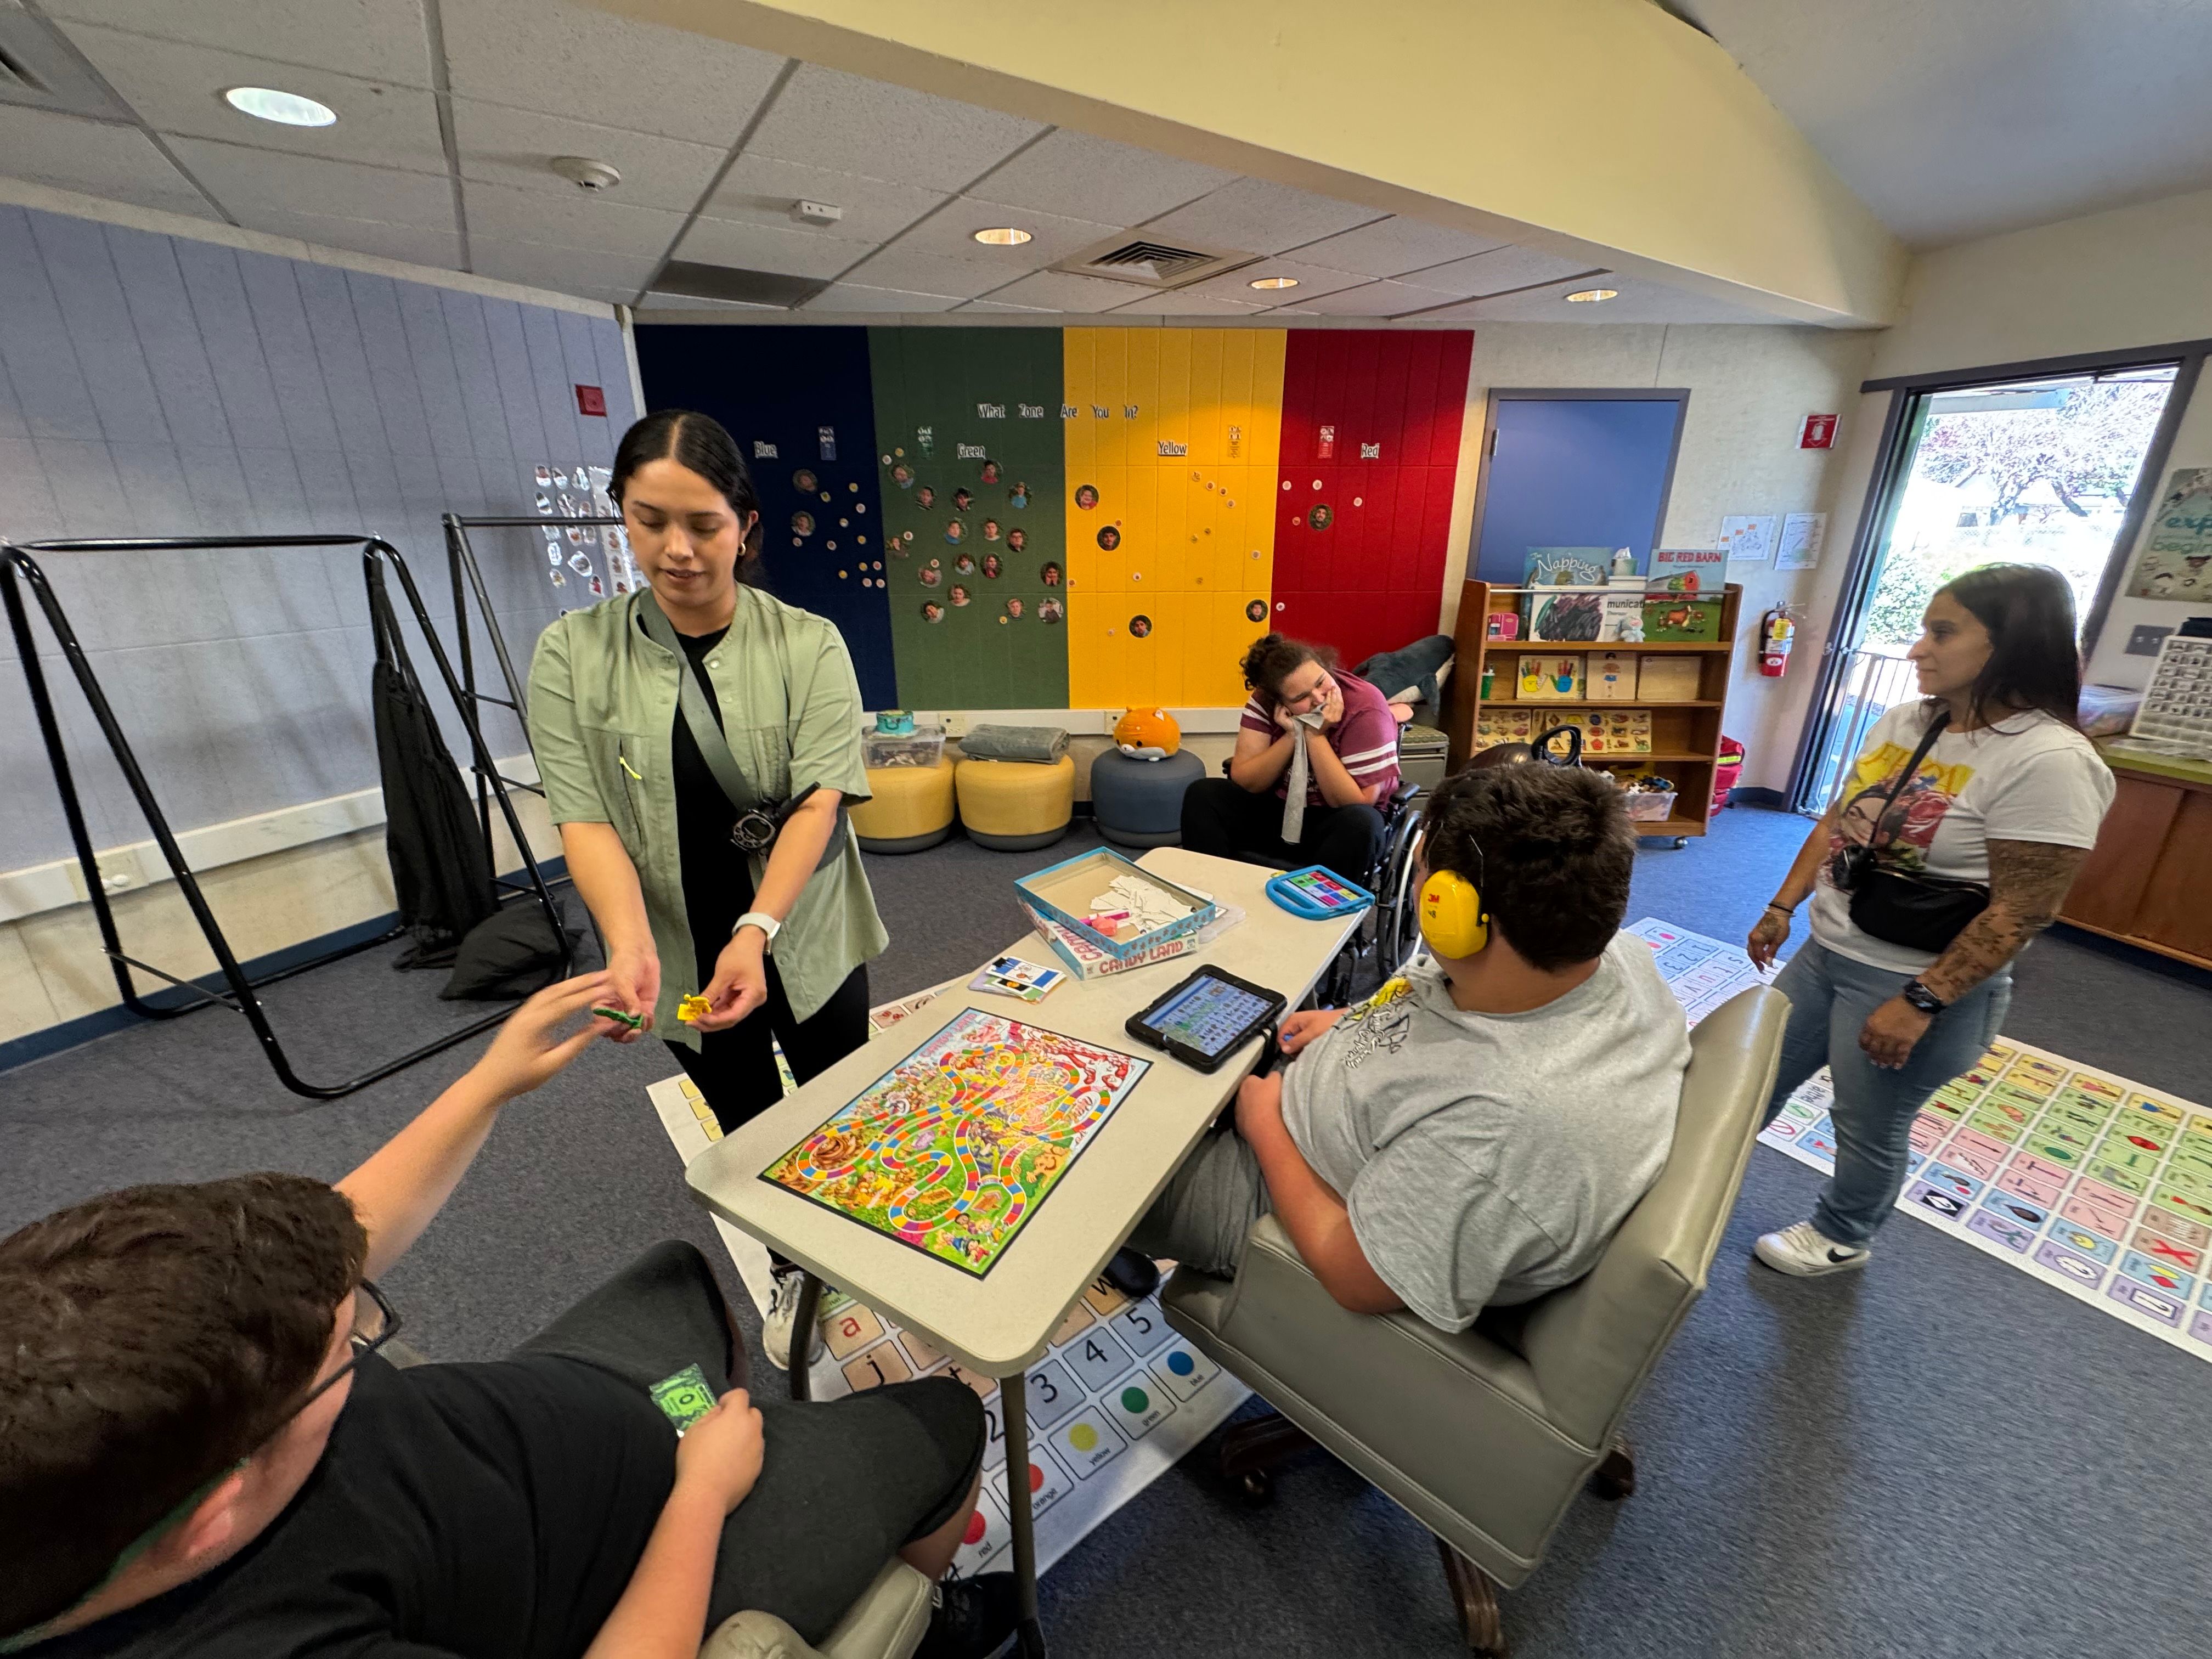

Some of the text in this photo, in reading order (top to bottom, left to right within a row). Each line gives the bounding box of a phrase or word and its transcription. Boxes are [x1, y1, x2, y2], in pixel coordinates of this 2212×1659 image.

[978, 403, 1138, 419] What Zone Are You In?
[754, 442, 777, 455] Blue
[958, 444, 985, 457] Green
[1158, 441, 1187, 455] Yellow
[1362, 444, 1378, 457] Red
[1676, 552, 1694, 563] RED
[1695, 552, 1722, 563] BARN
[1534, 552, 1598, 582] Napping
[1427, 893, 1440, 903] 3M
[1098, 940, 1183, 974] CANDY LAND
[839, 1317, 862, 1338] a
[1125, 1307, 1152, 1335] 5
[1086, 1339, 1109, 1363] 4
[1030, 1373, 1058, 1404] 3
[1189, 1373, 1205, 1387] blue
[984, 1409, 1006, 1442] 2
[1142, 1409, 1161, 1426] green
[1088, 1447, 1111, 1466] yellow
[1032, 1487, 1058, 1510] orange
[978, 1541, 993, 1559] red
